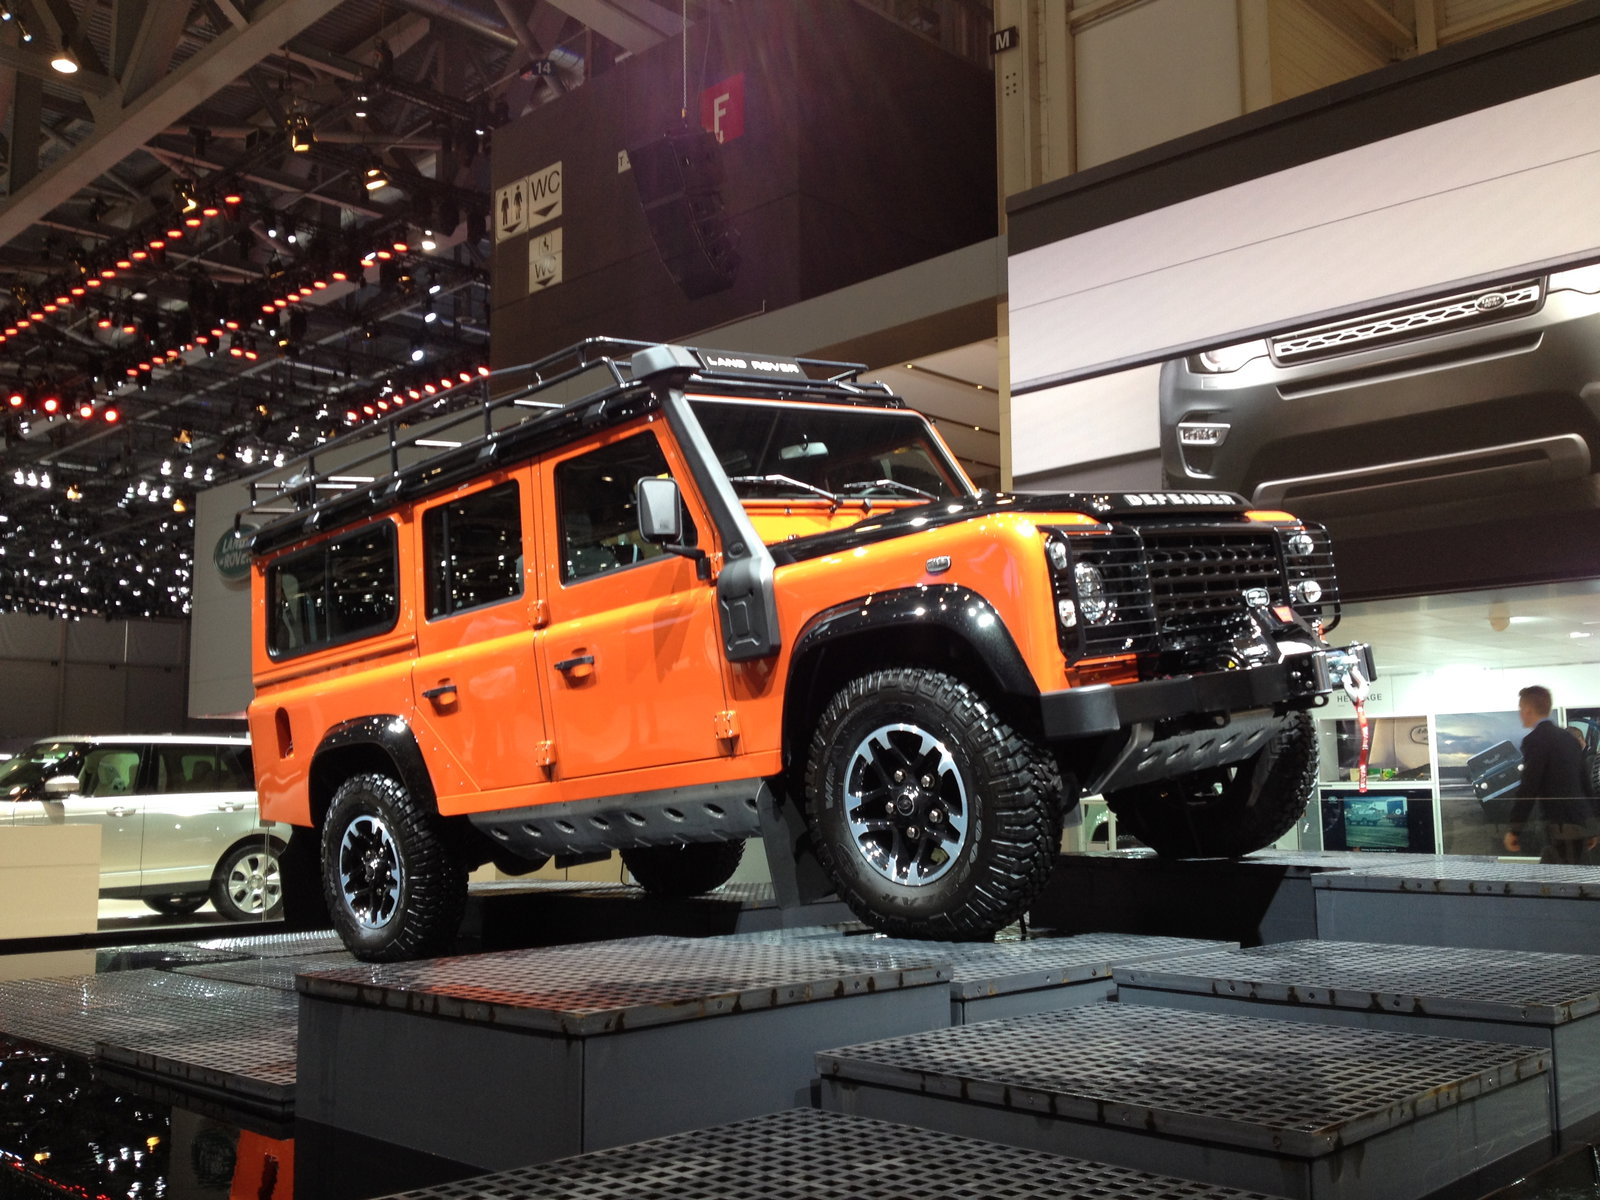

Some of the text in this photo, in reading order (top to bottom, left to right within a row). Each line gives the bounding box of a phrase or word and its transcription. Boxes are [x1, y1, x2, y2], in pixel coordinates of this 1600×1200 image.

[995, 30, 1010, 50] M
[536, 61, 551, 74] 14
[531, 170, 560, 201] WC
[706, 355, 800, 373] LAND ROVER
[1123, 493, 1236, 506] DEFENDER
